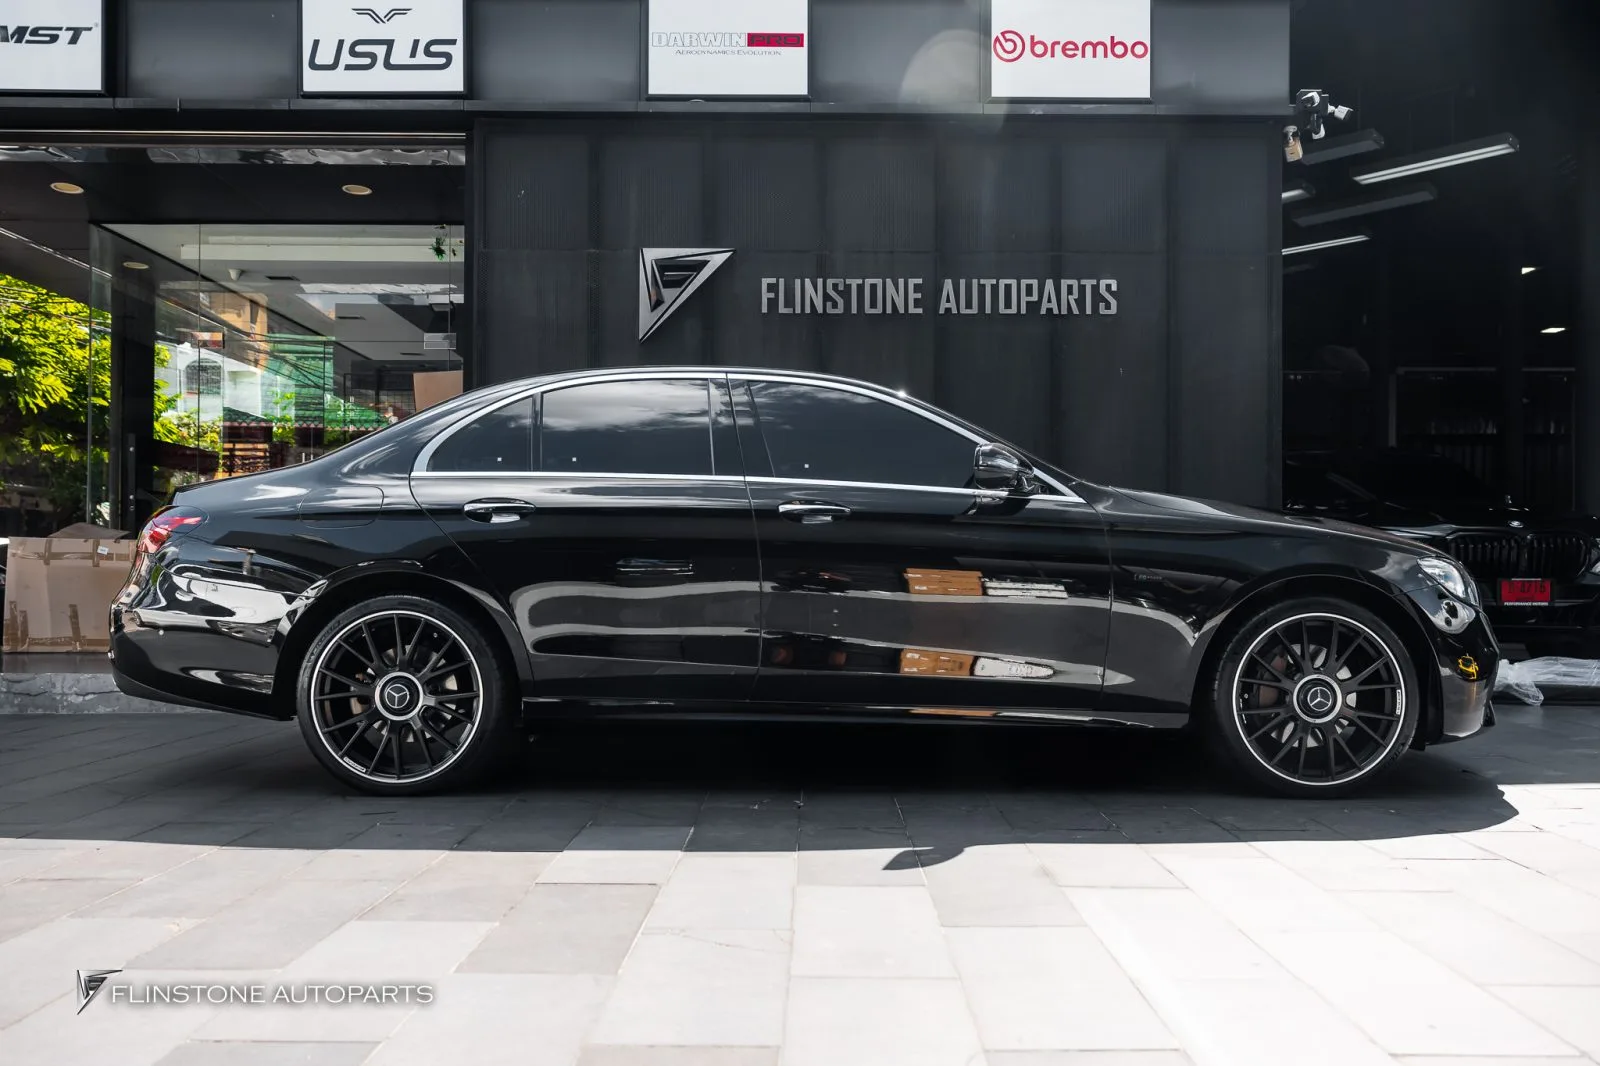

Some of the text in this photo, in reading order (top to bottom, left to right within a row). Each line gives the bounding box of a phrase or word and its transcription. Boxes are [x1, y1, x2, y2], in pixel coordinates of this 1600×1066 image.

[1030, 35, 1149, 59] brembo
[760, 277, 1119, 316] FLINSTONE AUTOPARTS
